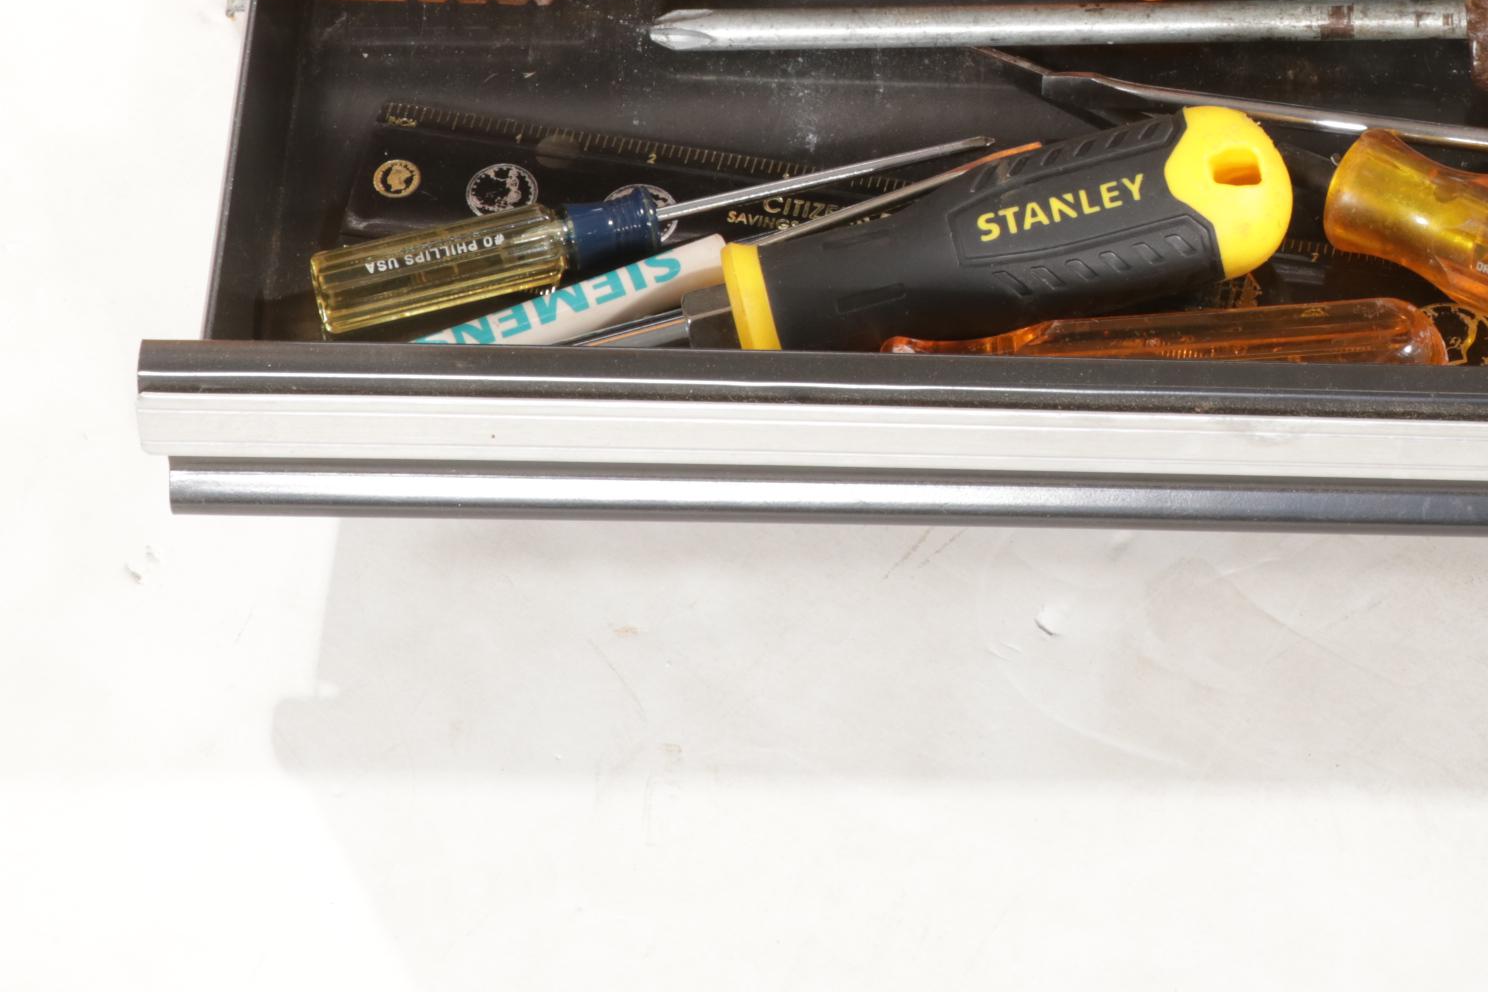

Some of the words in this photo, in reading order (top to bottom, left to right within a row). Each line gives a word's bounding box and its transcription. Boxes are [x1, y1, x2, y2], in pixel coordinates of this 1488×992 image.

[977, 173, 1144, 242] STANLEY
[364, 256, 400, 275] USA
[404, 241, 478, 267] PHILLIPS
[413, 249, 682, 344] SIEMEN
